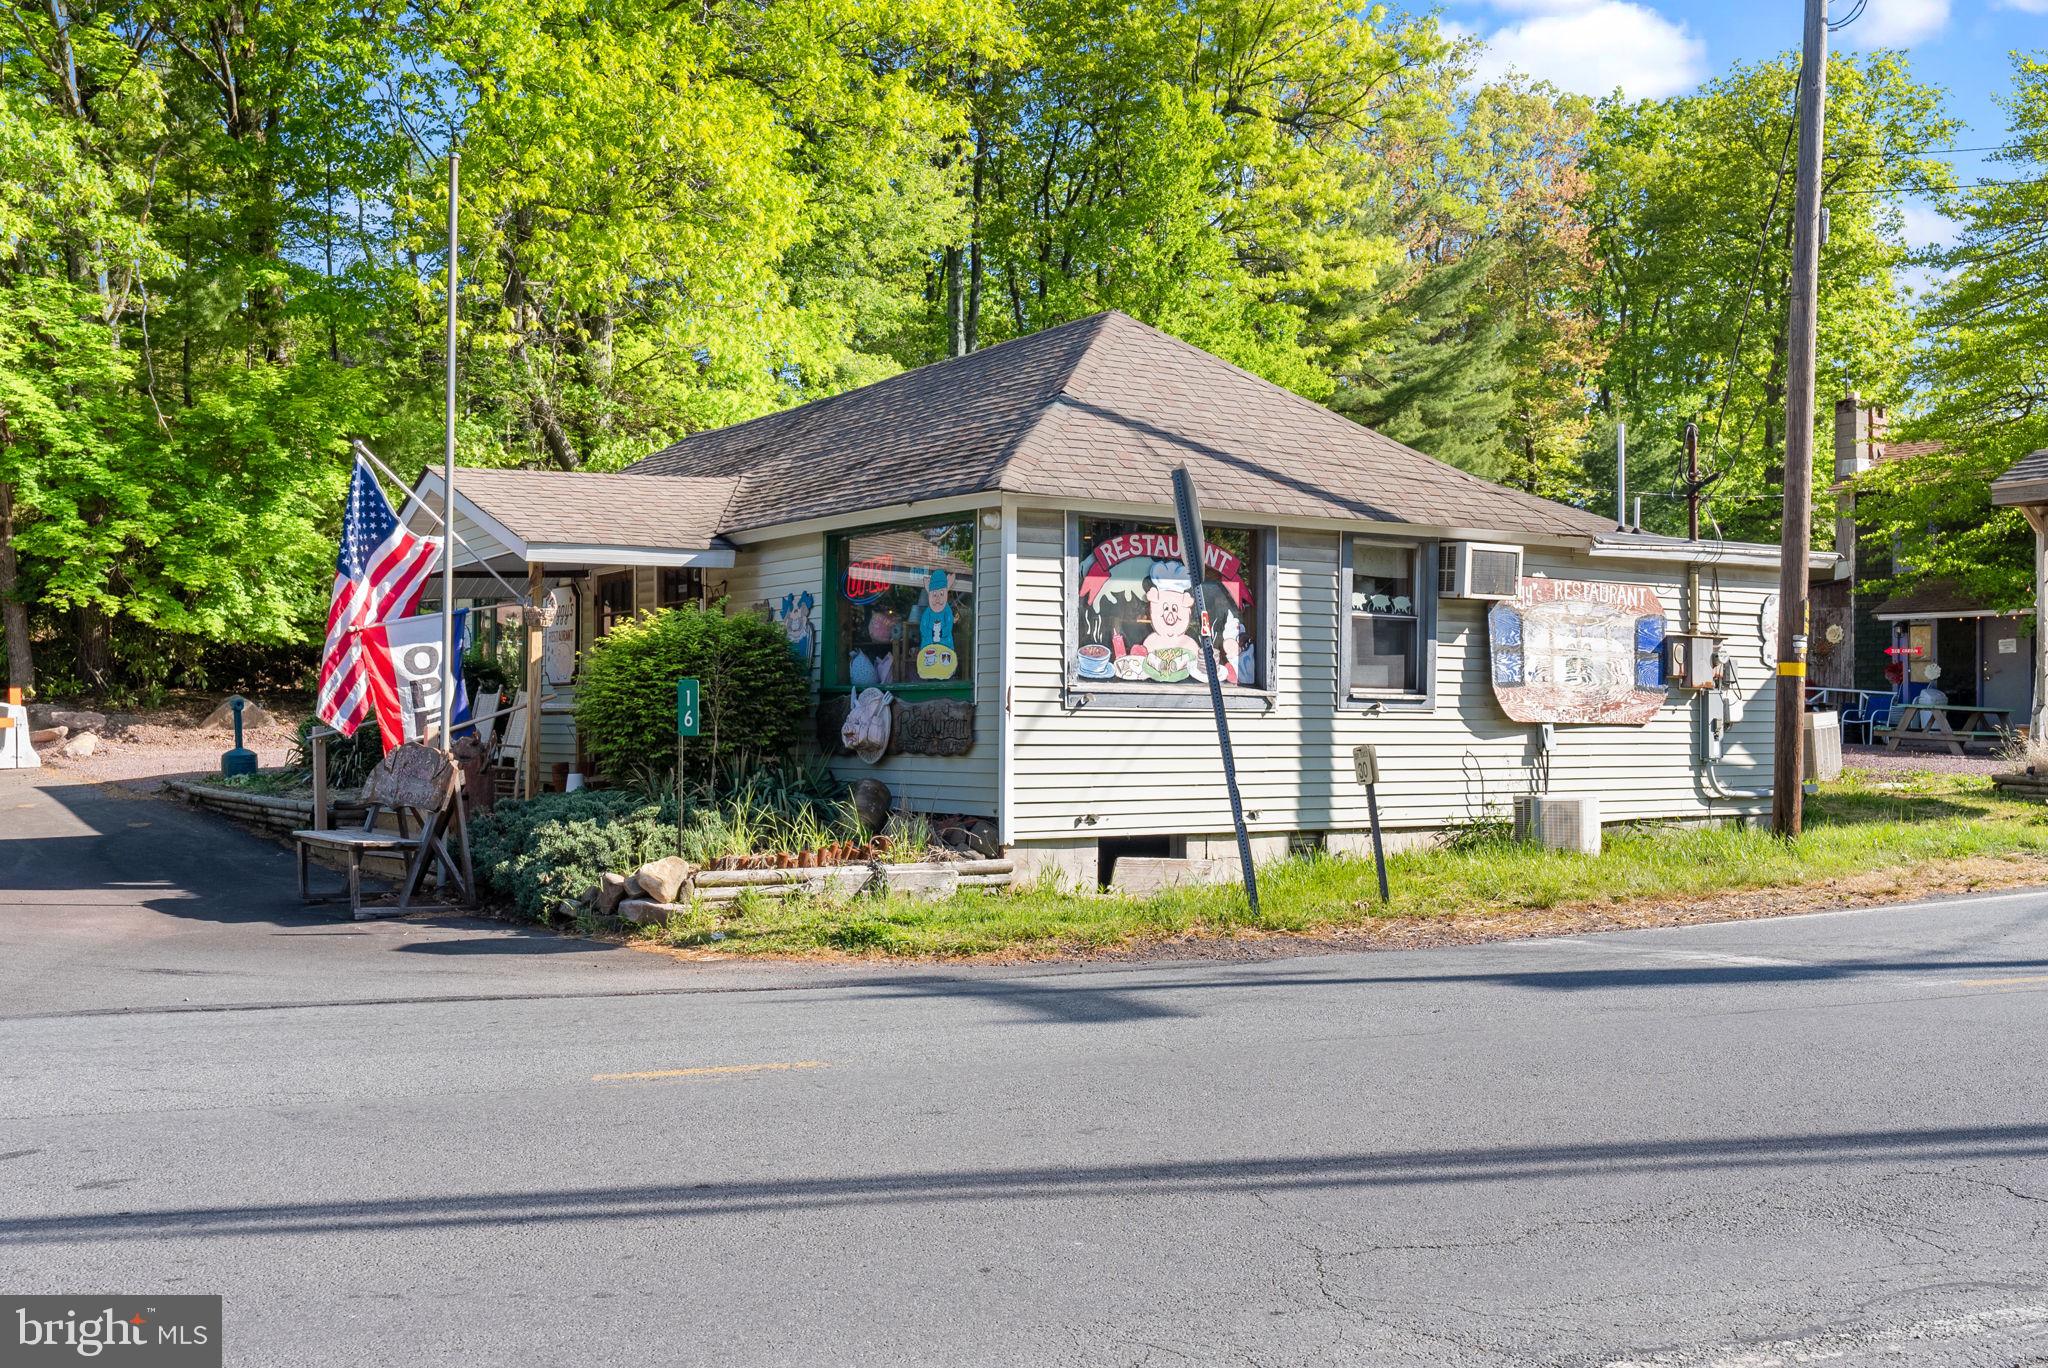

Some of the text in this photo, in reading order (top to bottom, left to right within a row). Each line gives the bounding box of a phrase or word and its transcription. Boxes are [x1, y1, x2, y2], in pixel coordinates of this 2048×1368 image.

[1100, 534, 1233, 573] RESTAUNT
[847, 555, 892, 598] OPEN
[1554, 581, 1647, 607] RESTAURANT
[404, 645, 441, 737] OPE
[684, 689, 693, 728] 16
[1357, 761, 1369, 780] 30
